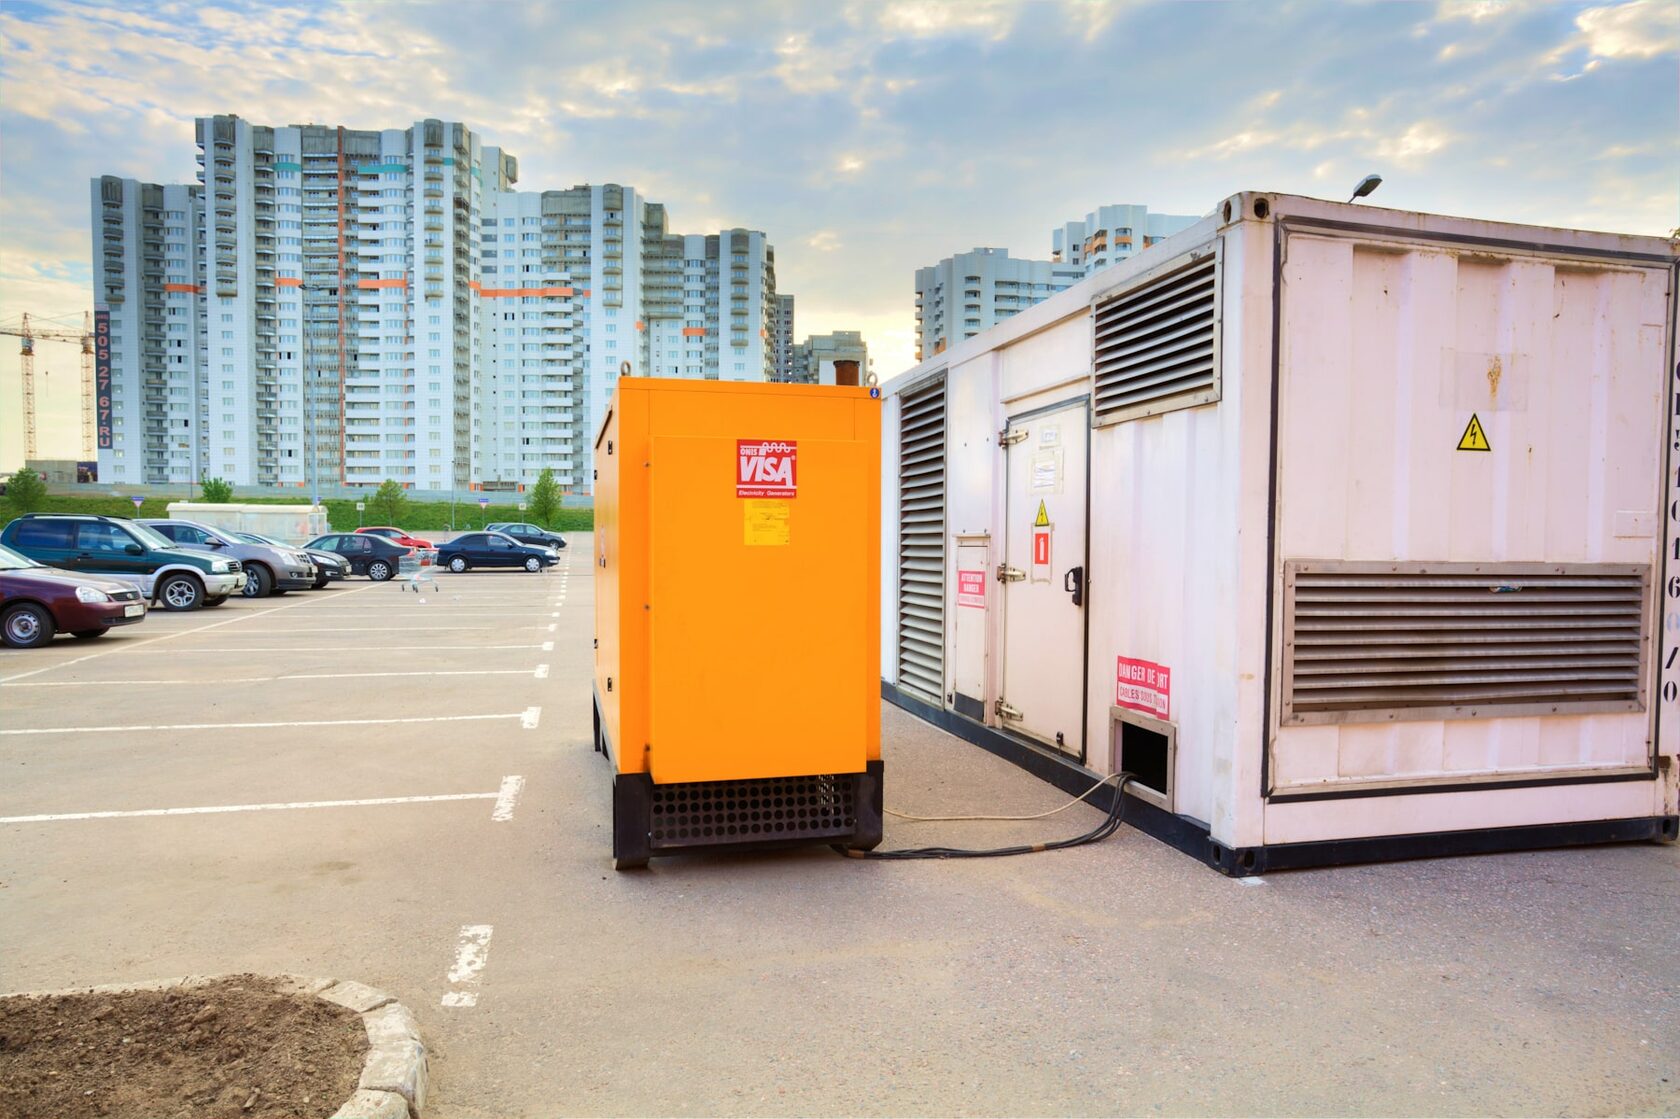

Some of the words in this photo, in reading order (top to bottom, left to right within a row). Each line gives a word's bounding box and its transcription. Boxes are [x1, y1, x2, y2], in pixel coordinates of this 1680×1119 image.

[740, 456, 793, 488] VISA
[1119, 663, 1145, 682] DANGER
[1147, 668, 1156, 685] DE
